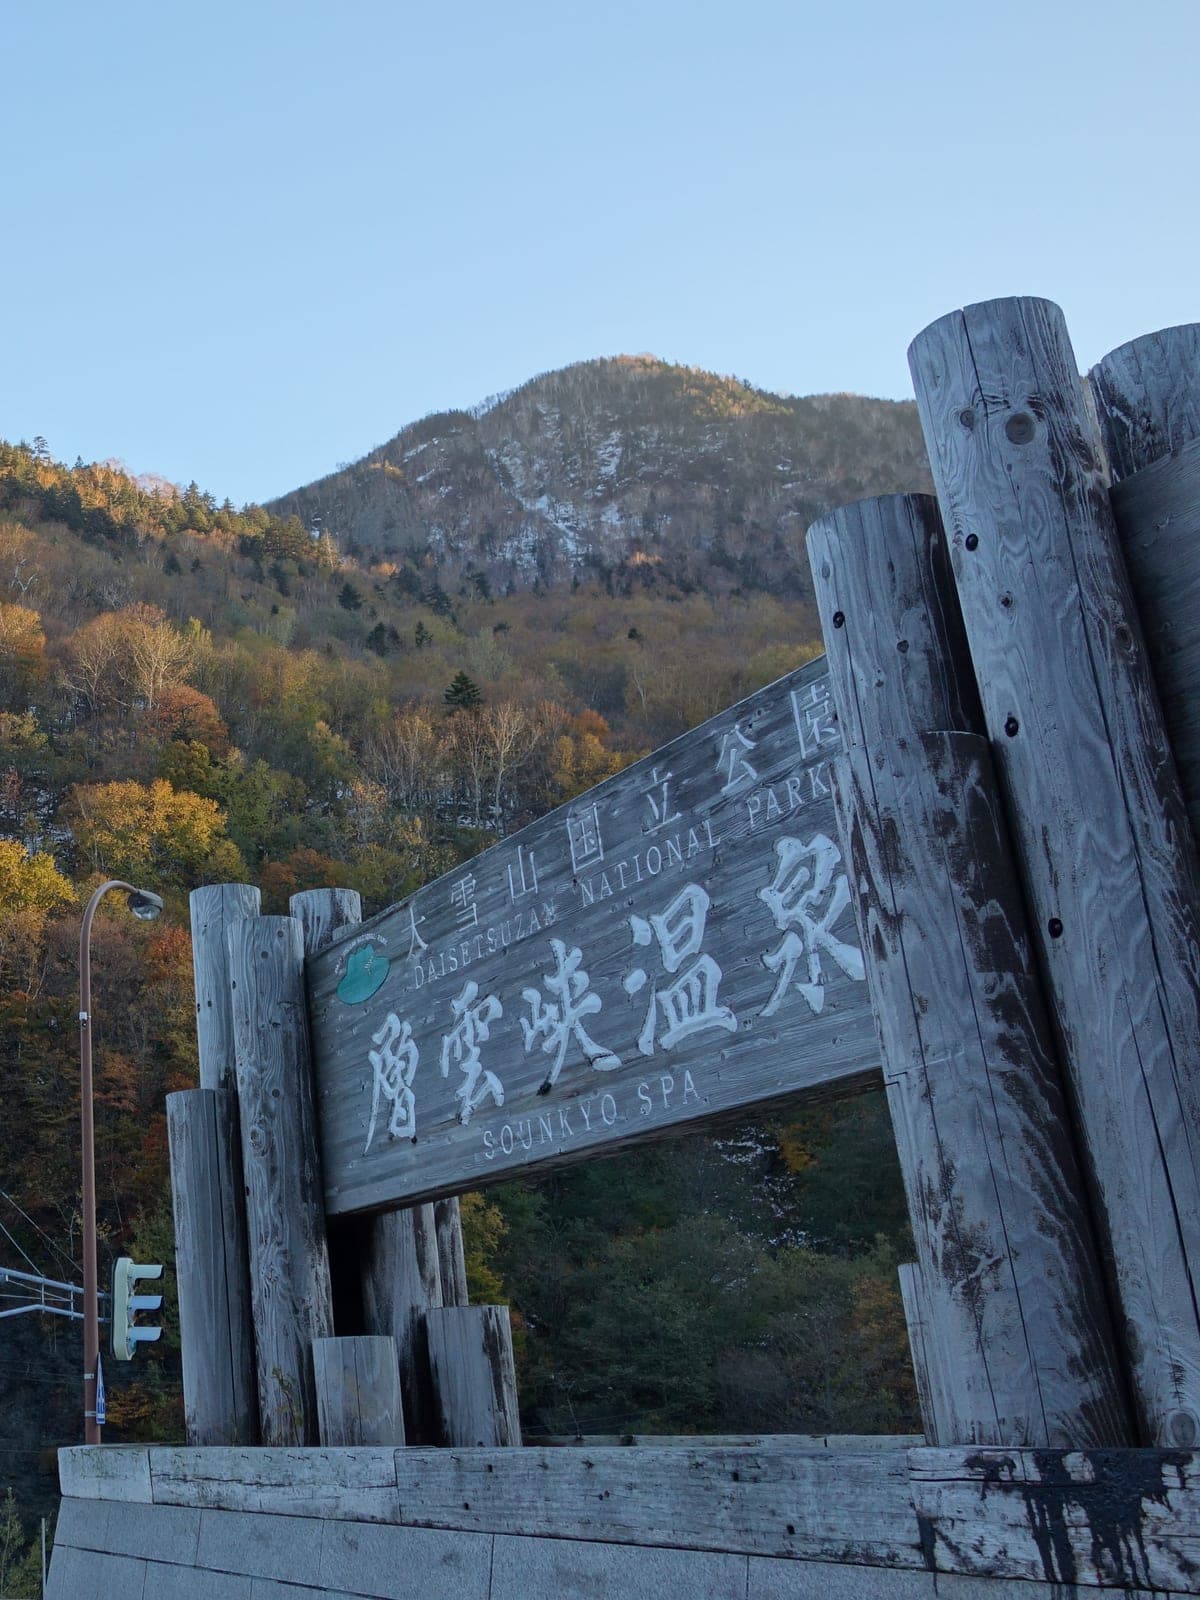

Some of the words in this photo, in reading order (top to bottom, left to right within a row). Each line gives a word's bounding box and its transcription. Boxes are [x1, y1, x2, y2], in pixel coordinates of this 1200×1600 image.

[406, 674, 842, 962] 大雪山国立公園
[413, 900, 557, 990] DAISETSUZAN
[580, 818, 721, 908] NATIONAL
[746, 761, 831, 825] PARK
[483, 1092, 618, 1160] SOUNKYO
[638, 1069, 702, 1116] SPA
